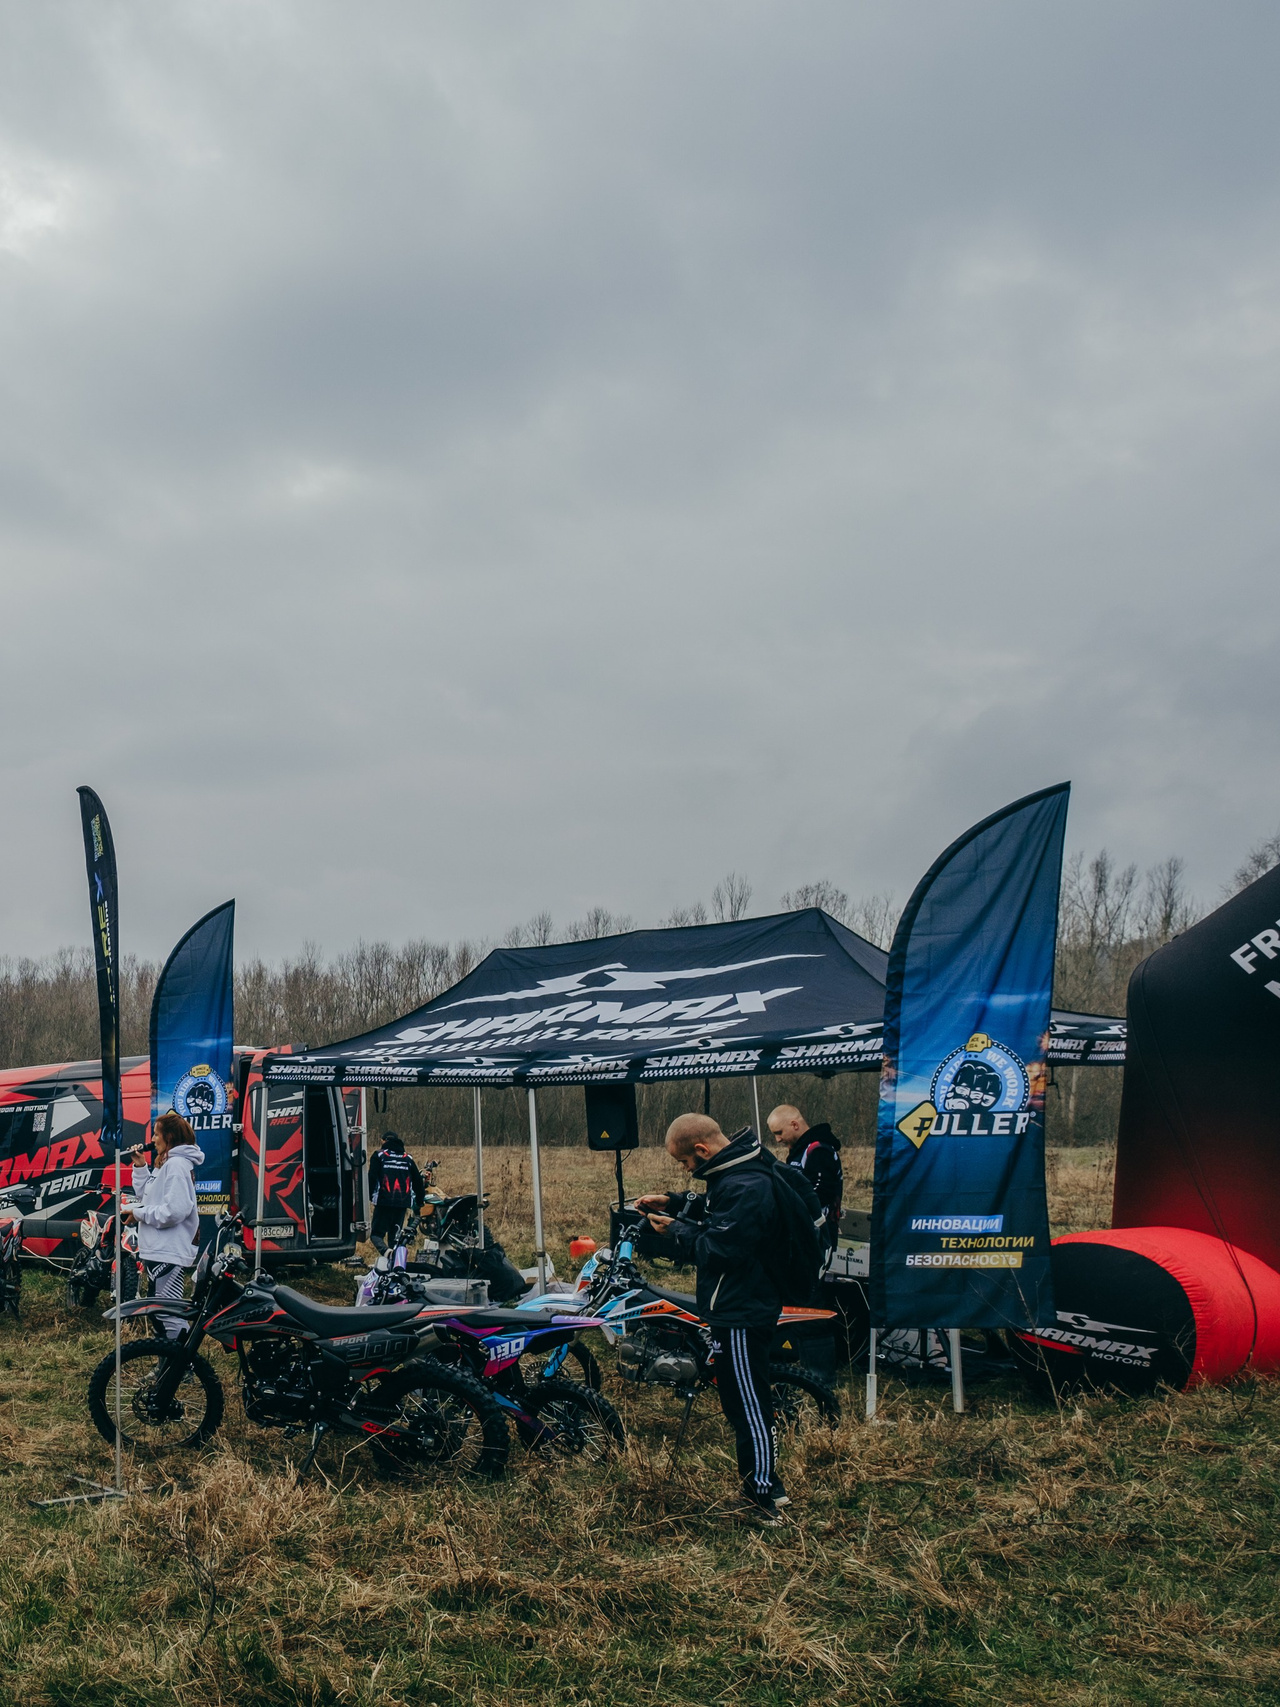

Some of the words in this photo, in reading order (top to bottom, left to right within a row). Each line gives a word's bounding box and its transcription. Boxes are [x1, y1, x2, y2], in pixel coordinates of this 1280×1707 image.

[375, 986, 803, 1046] SHARMAX
[575, 1018, 749, 1041] RACE
[645, 1048, 763, 1069] SHARMAX
[269, 1065, 336, 1075] SHARMAX
[344, 1066, 423, 1077] SHARMAX
[429, 1067, 519, 1077] SHARMAX
[526, 1059, 629, 1077] SHARMAX
[715, 1062, 757, 1073] RACE
[392, 1076, 418, 1084] RACE
[591, 1071, 627, 1081] RACE
[986, 1050, 1008, 1069] WE
[1002, 1066, 1020, 1110] WORK
[178, 1078, 194, 1097] RIDE
[24, 1104, 49, 1112] MOTION
[177, 1097, 186, 1116] YOU
[270, 1116, 300, 1126] RACE
[914, 1112, 1030, 1137] PULLER
[39, 1169, 93, 1198] TEAM
[911, 1218, 999, 1232] ИННОВАЦИИ
[940, 1236, 1034, 1249] ТЕХНОЛОГИИ
[905, 1254, 1018, 1266] БЕЗОПАСНОСТЬ
[333, 1334, 370, 1346] SPORT
[1091, 1352, 1151, 1368] MOTORS
